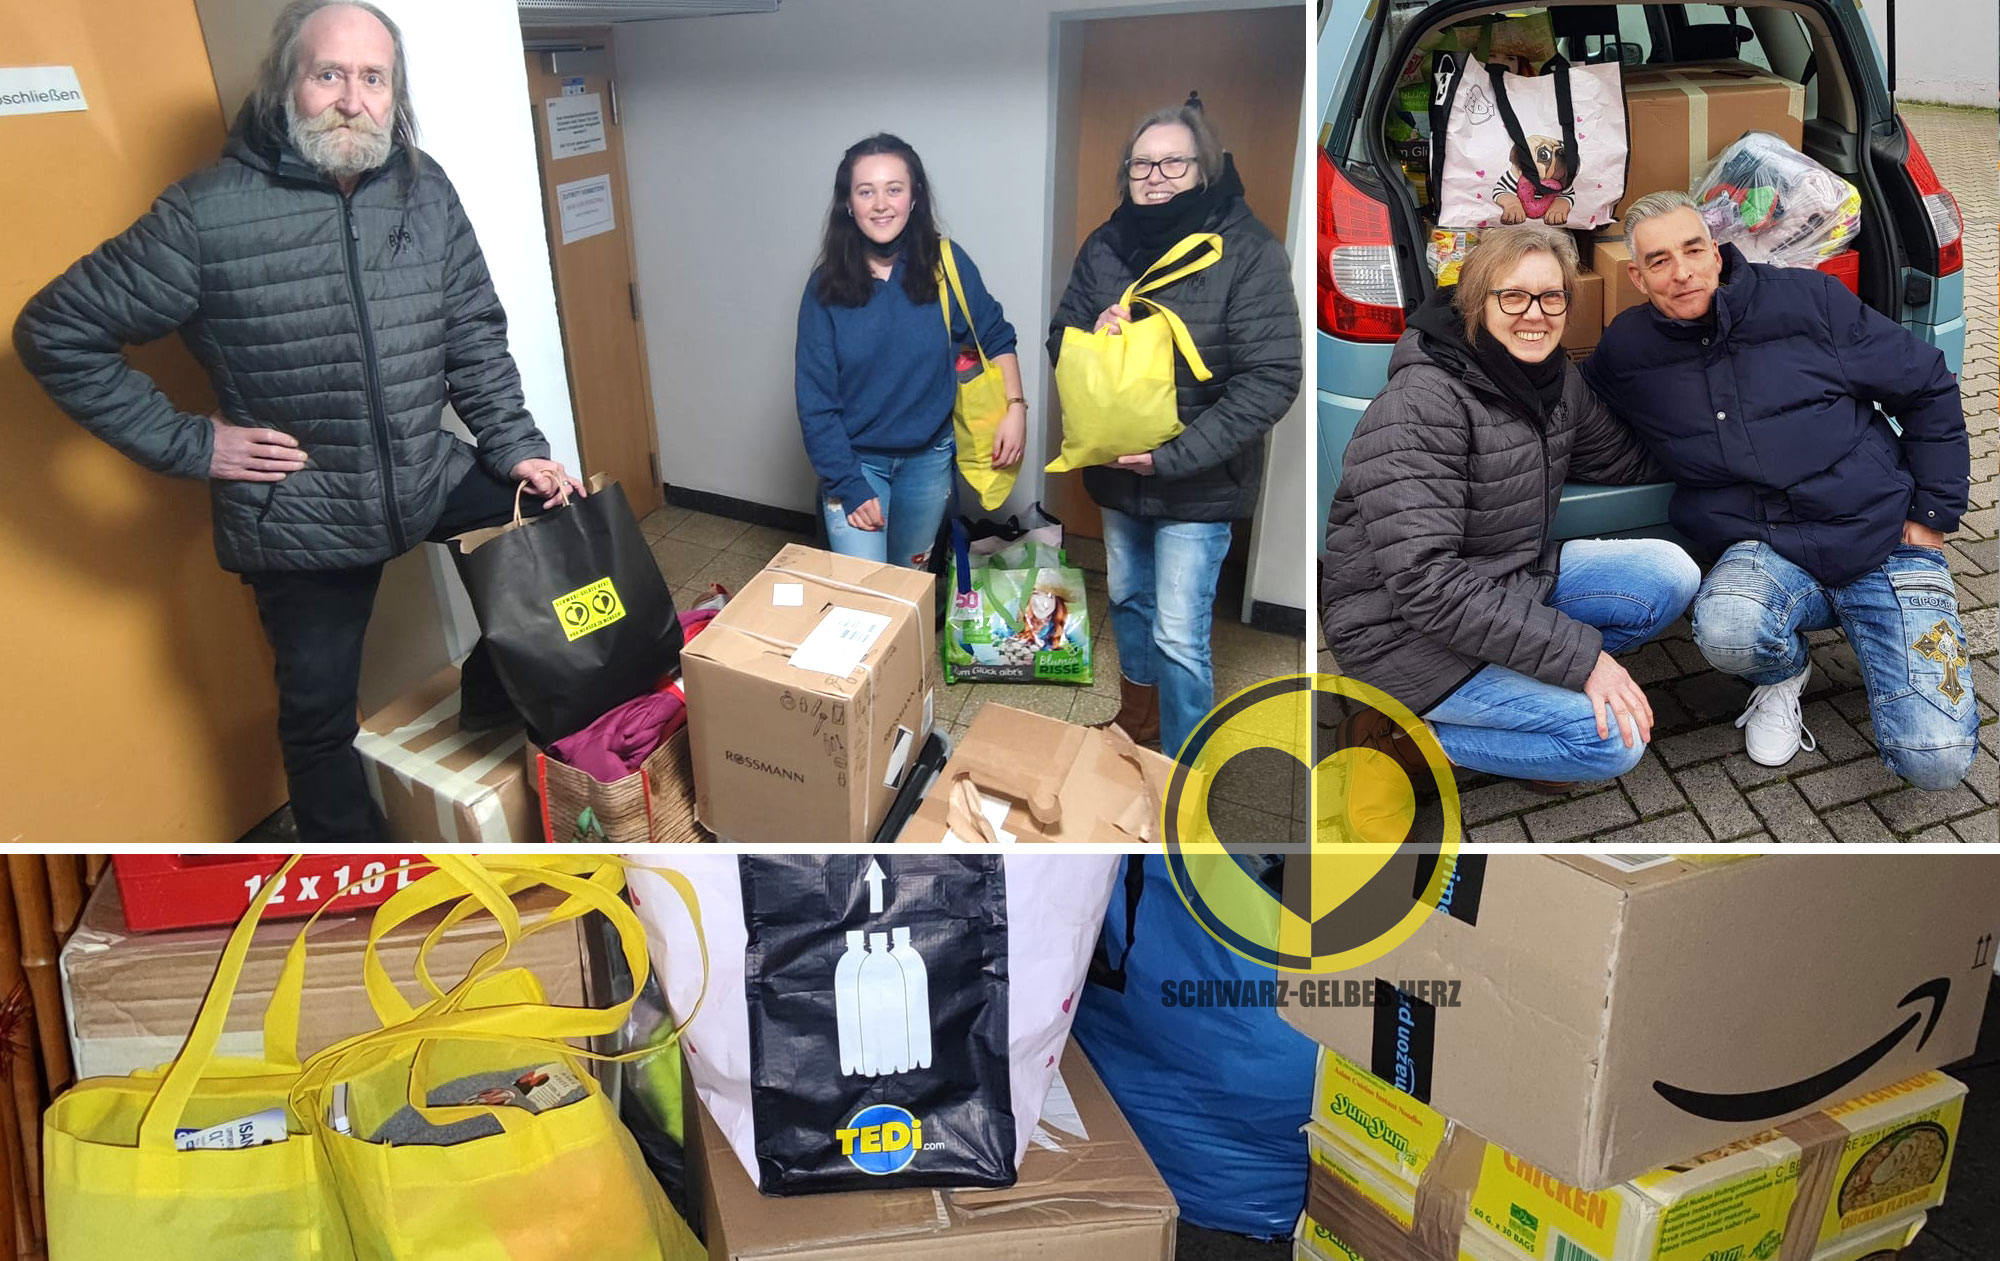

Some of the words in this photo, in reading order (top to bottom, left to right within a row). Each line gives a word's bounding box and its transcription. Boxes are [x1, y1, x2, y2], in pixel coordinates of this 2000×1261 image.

[0, 88, 81, 106] schließen
[1039, 665, 1080, 675] RISSE
[725, 750, 805, 783] ROSSMANN
[296, 876, 321, 901] x
[1439, 855, 1461, 915] rime
[1393, 1026, 1412, 1091] mazon
[836, 1119, 922, 1155] TEDi
[1474, 1207, 1484, 1218] 60
[1502, 1226, 1512, 1238] 30
[1513, 1232, 1535, 1253] BAGS
